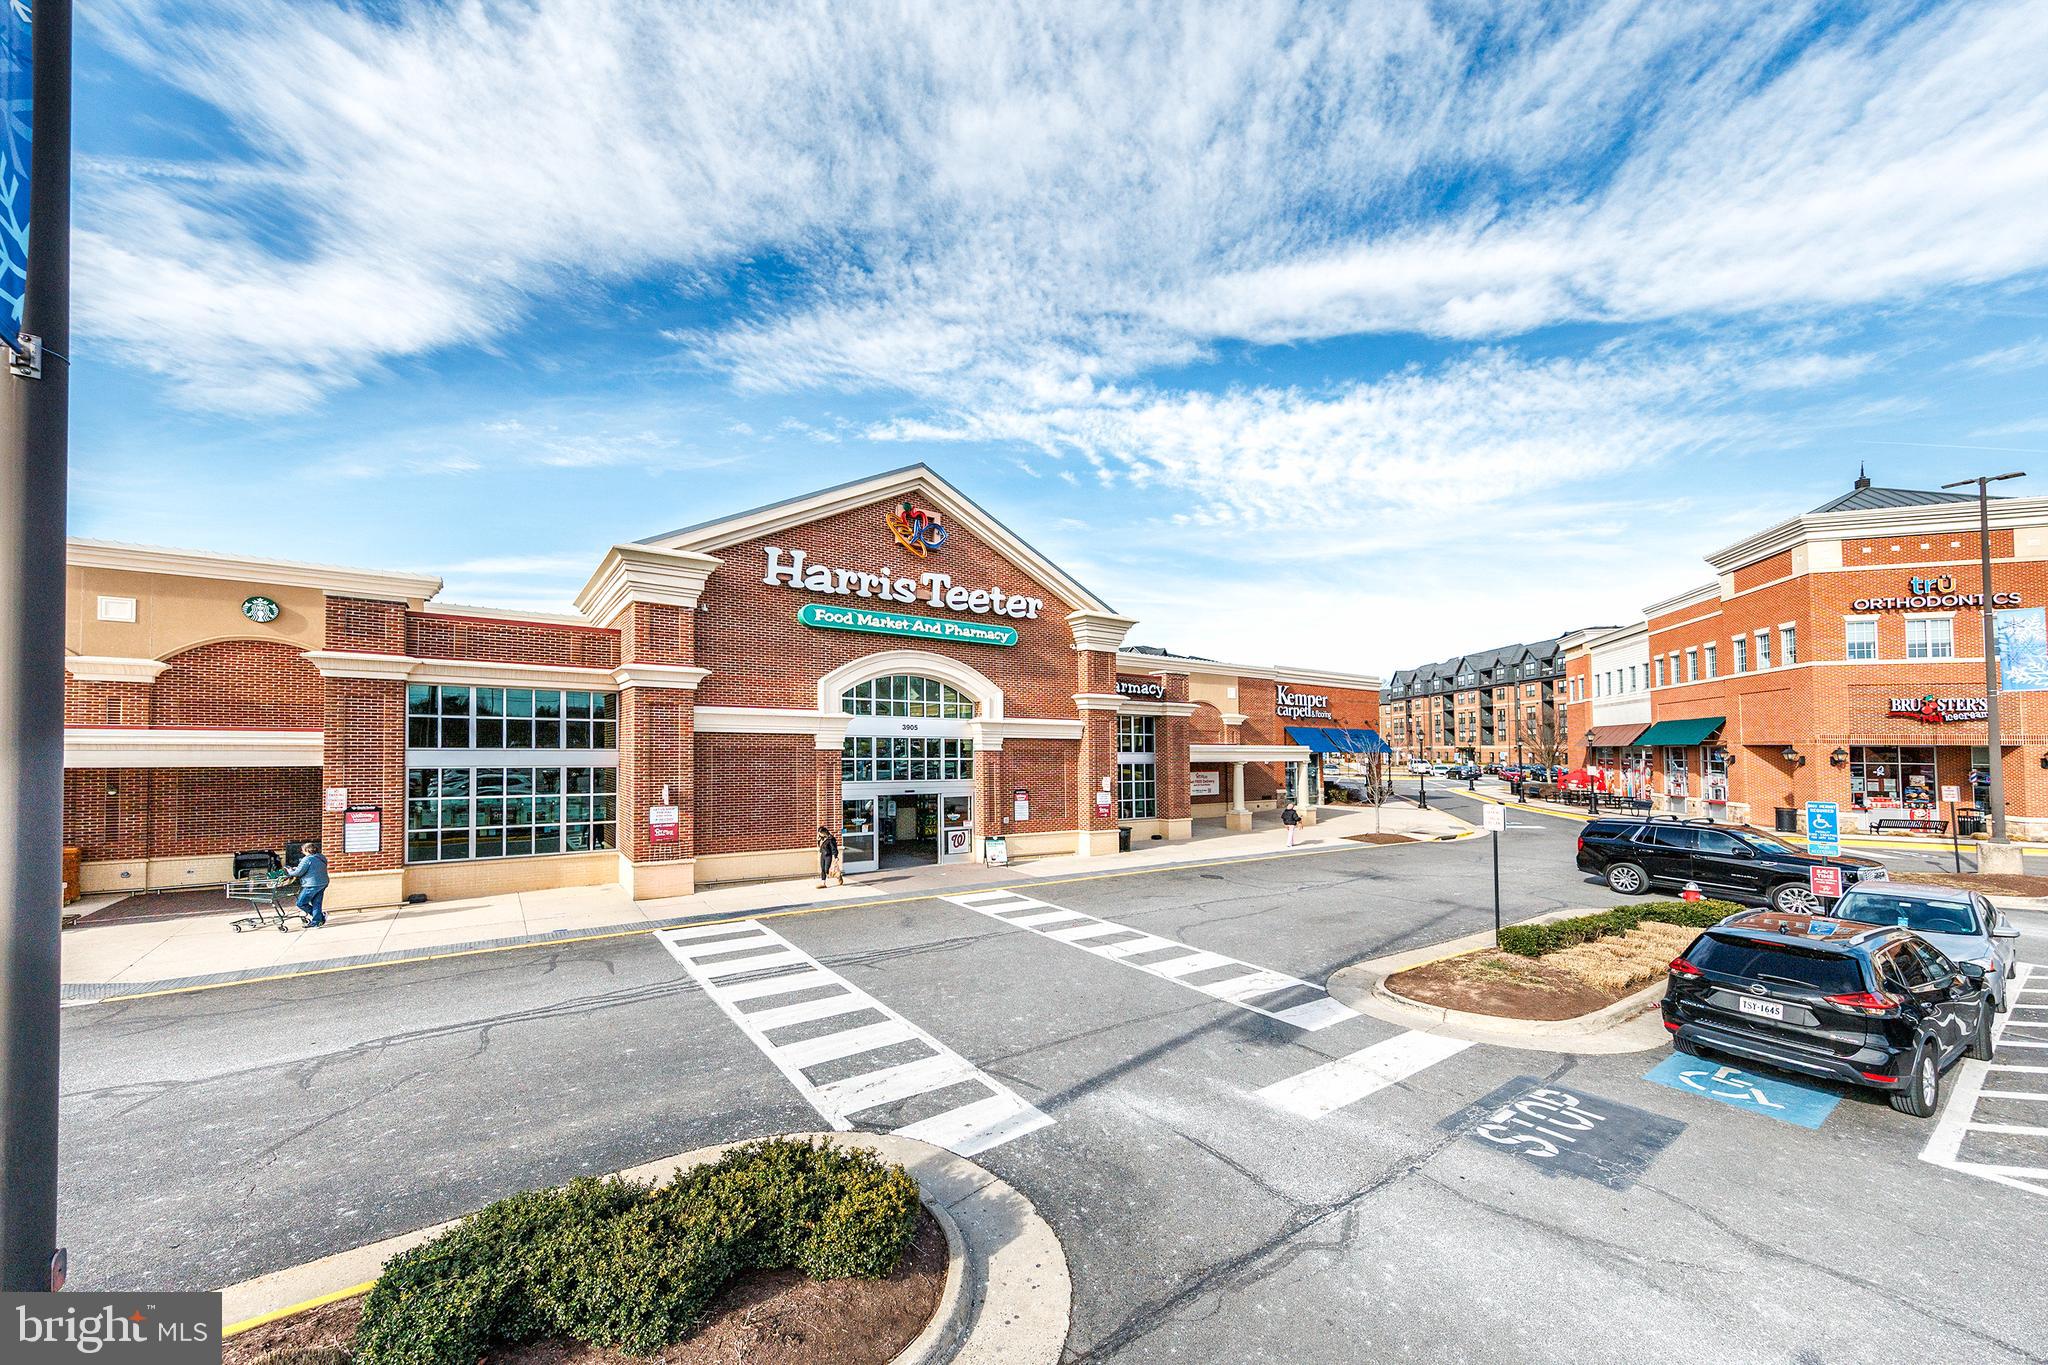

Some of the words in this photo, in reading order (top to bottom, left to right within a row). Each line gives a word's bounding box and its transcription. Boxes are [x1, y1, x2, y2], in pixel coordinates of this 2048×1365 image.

[762, 546, 916, 604] Harris
[921, 572, 1044, 619] Teeter
[1853, 592, 2022, 610] ORTHODONTCS
[813, 608, 853, 625] Food
[857, 612, 909, 631] Market
[912, 620, 941, 634] And
[945, 624, 1013, 643] Pharmacy
[1277, 685, 1328, 711] Kemper
[1476, 1089, 1606, 1158] STOP
